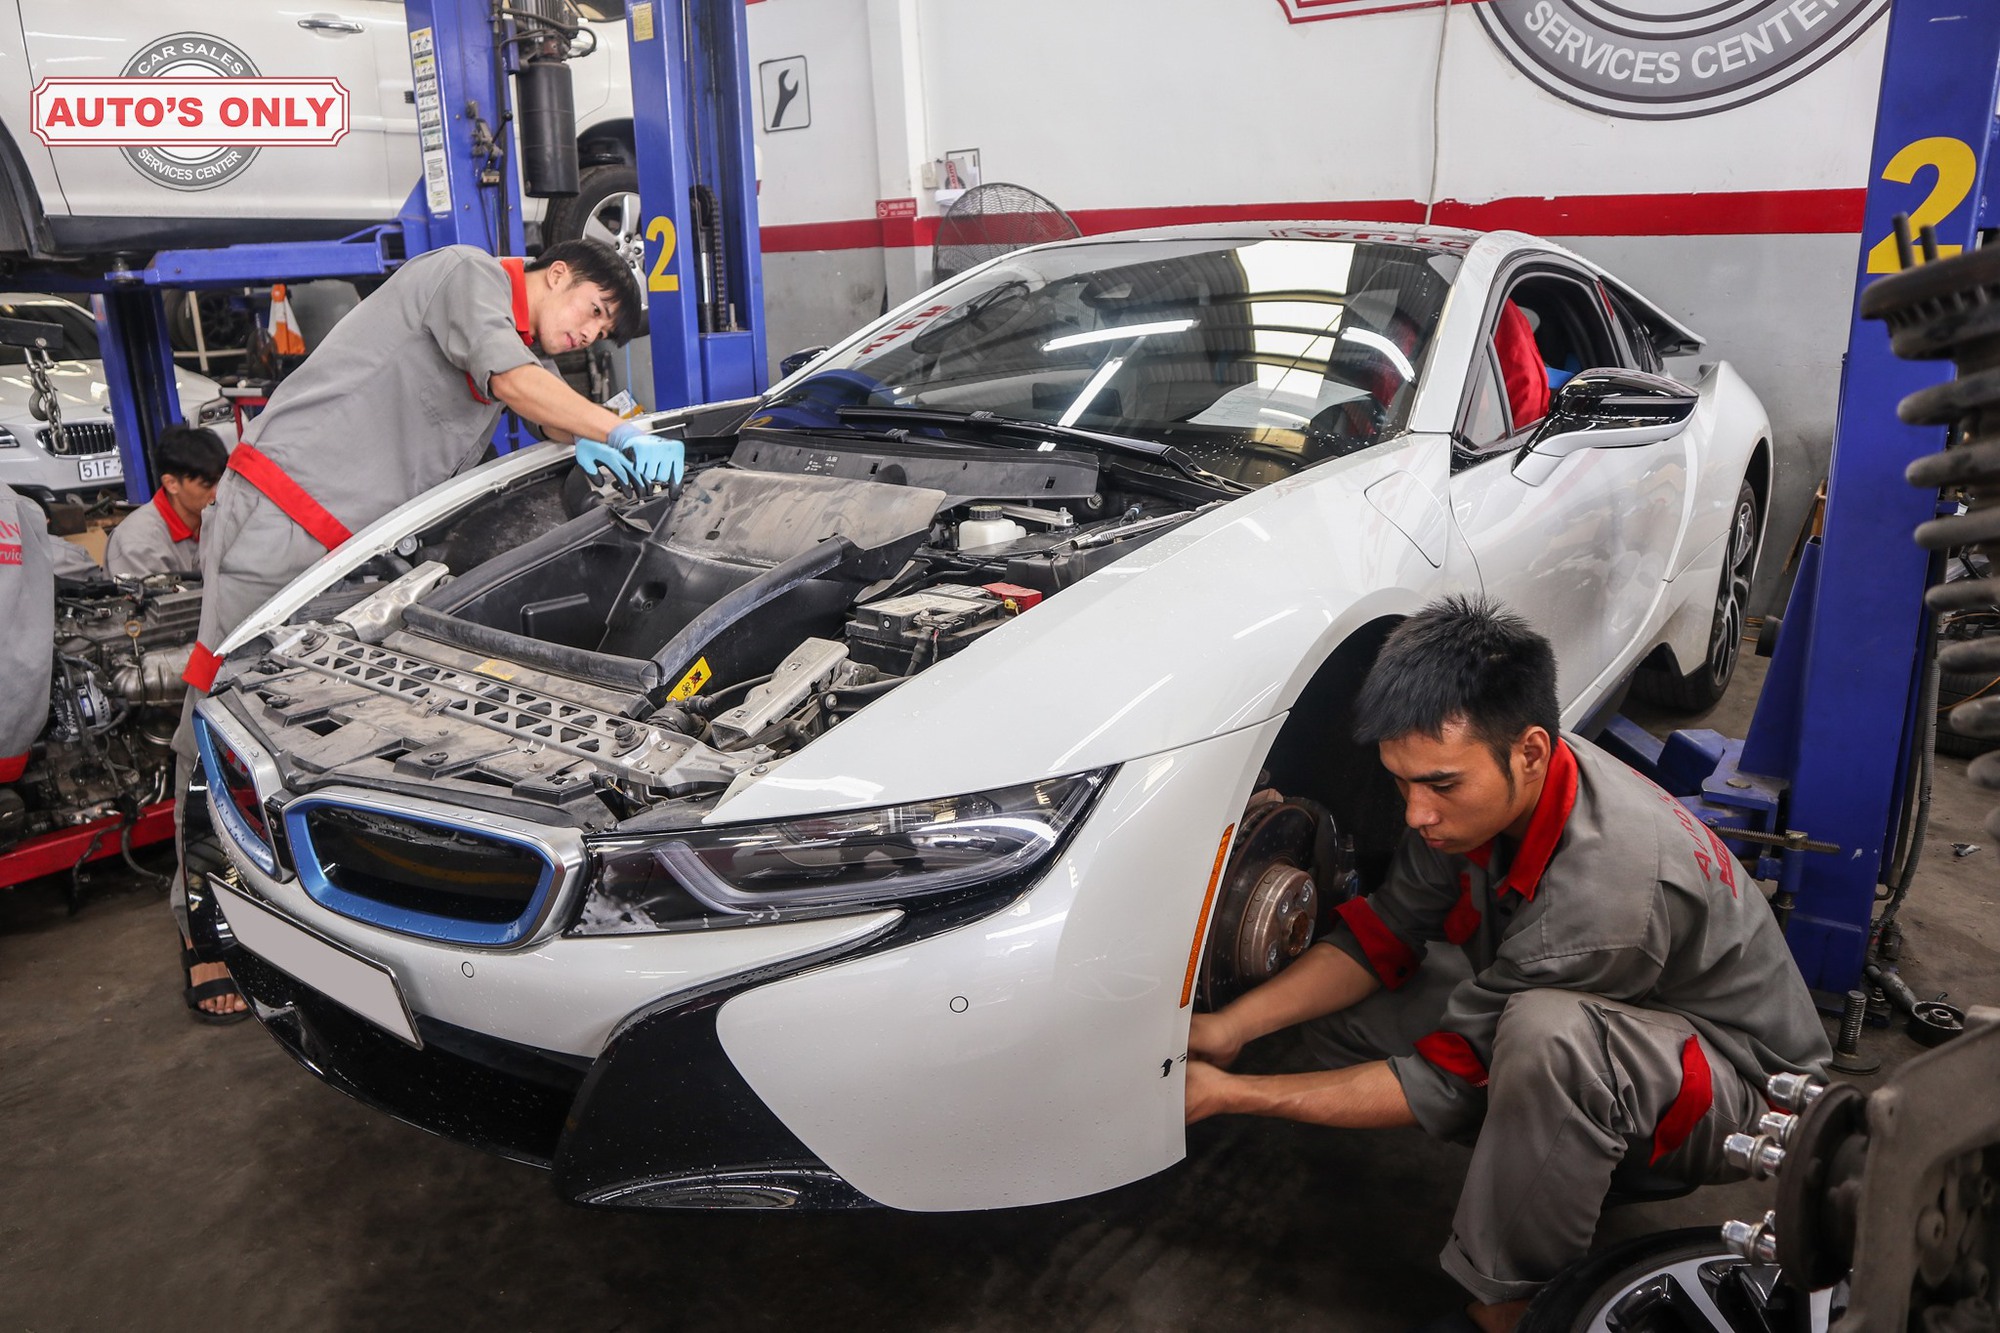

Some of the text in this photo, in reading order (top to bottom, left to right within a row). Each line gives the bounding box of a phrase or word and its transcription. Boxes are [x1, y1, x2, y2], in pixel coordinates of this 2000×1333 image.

[1524, 0, 1839, 84] SERVICES CENTE
[1866, 136, 1977, 274] 2
[645, 215, 679, 292] 2
[82, 460, 123, 478] 51F-
